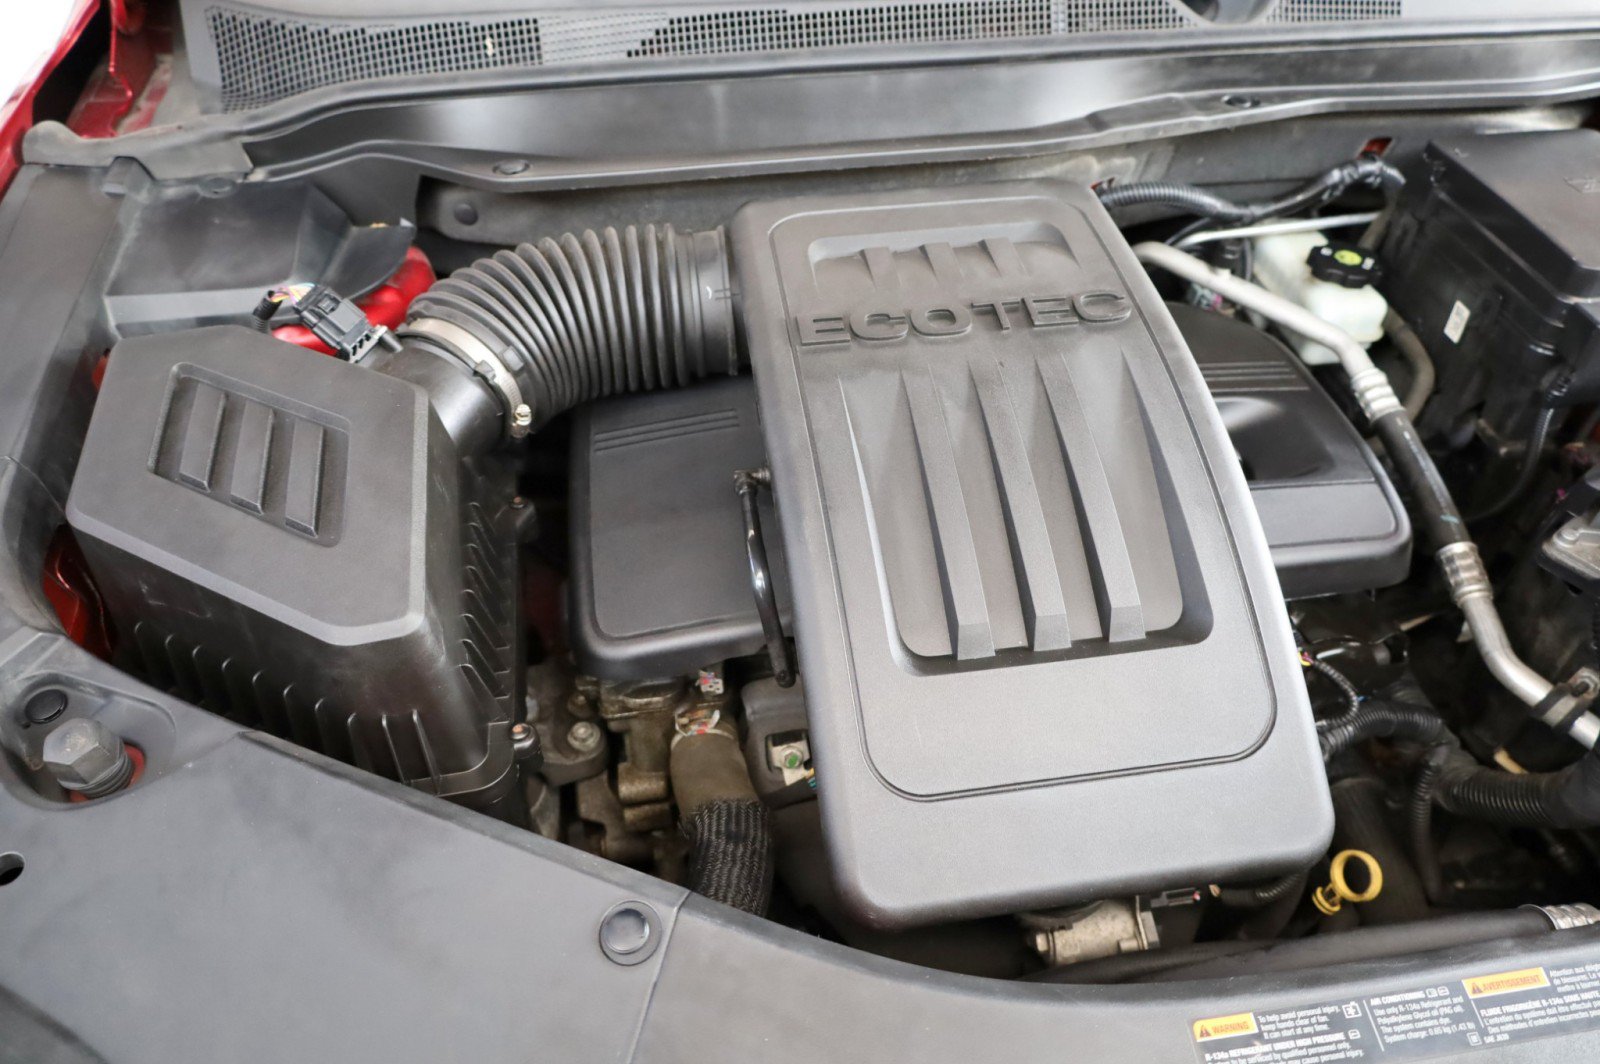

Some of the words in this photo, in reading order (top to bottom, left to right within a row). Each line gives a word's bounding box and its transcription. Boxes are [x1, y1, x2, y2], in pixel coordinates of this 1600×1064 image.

[796, 292, 1132, 346] ECOTEC
[1483, 974, 1540, 990] AVERTISSEMENT
[1257, 1015, 1267, 1023] To
[1212, 1021, 1250, 1034] WARNING
